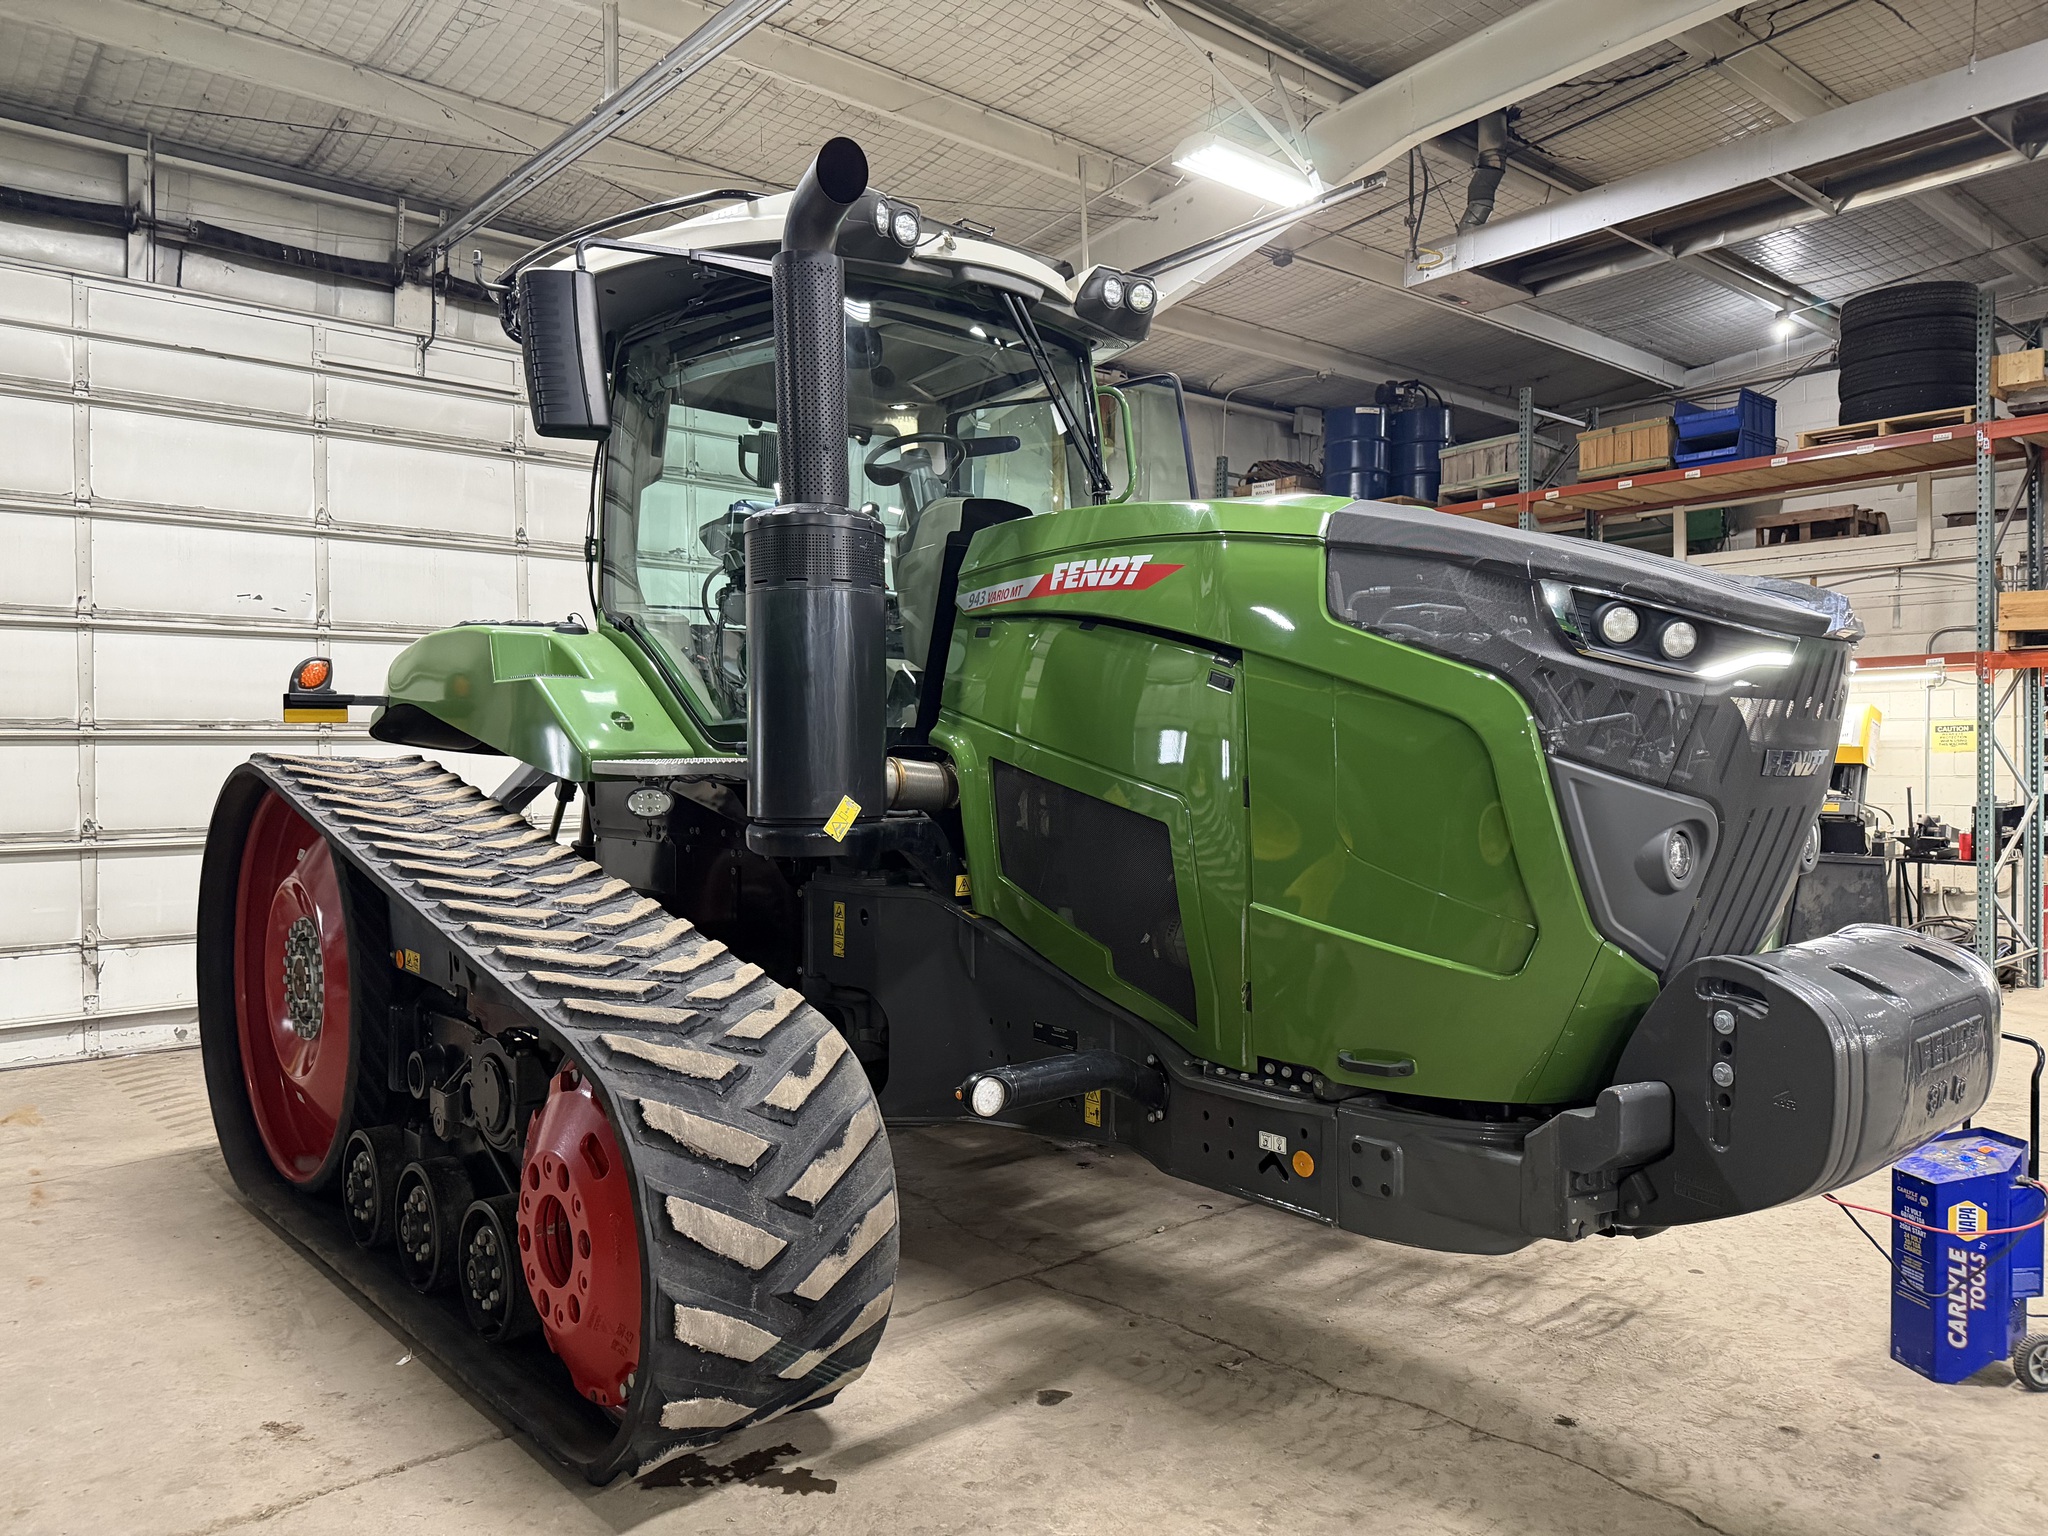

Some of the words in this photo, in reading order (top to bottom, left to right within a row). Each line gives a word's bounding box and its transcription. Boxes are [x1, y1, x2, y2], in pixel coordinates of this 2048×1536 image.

[1050, 554, 1154, 591] FENDT
[968, 590, 986, 609] 943
[987, 588, 1010, 604] VARIO
[1010, 584, 1024, 599] MT
[1936, 725, 1970, 733] CAUTION
[1761, 749, 1830, 777] FENDT
[1915, 1014, 1984, 1076] FENDT
[1896, 1185, 1919, 1198] CARLYLE
[1905, 1194, 1918, 1203] TOOLS
[1903, 1205, 1910, 1213] 12
[1910, 1207, 1923, 1218] VOLT
[1978, 1241, 1988, 1250] by
[1970, 1251, 1986, 1311] TOOLS
[1948, 1247, 1968, 1349] CARLYLE
